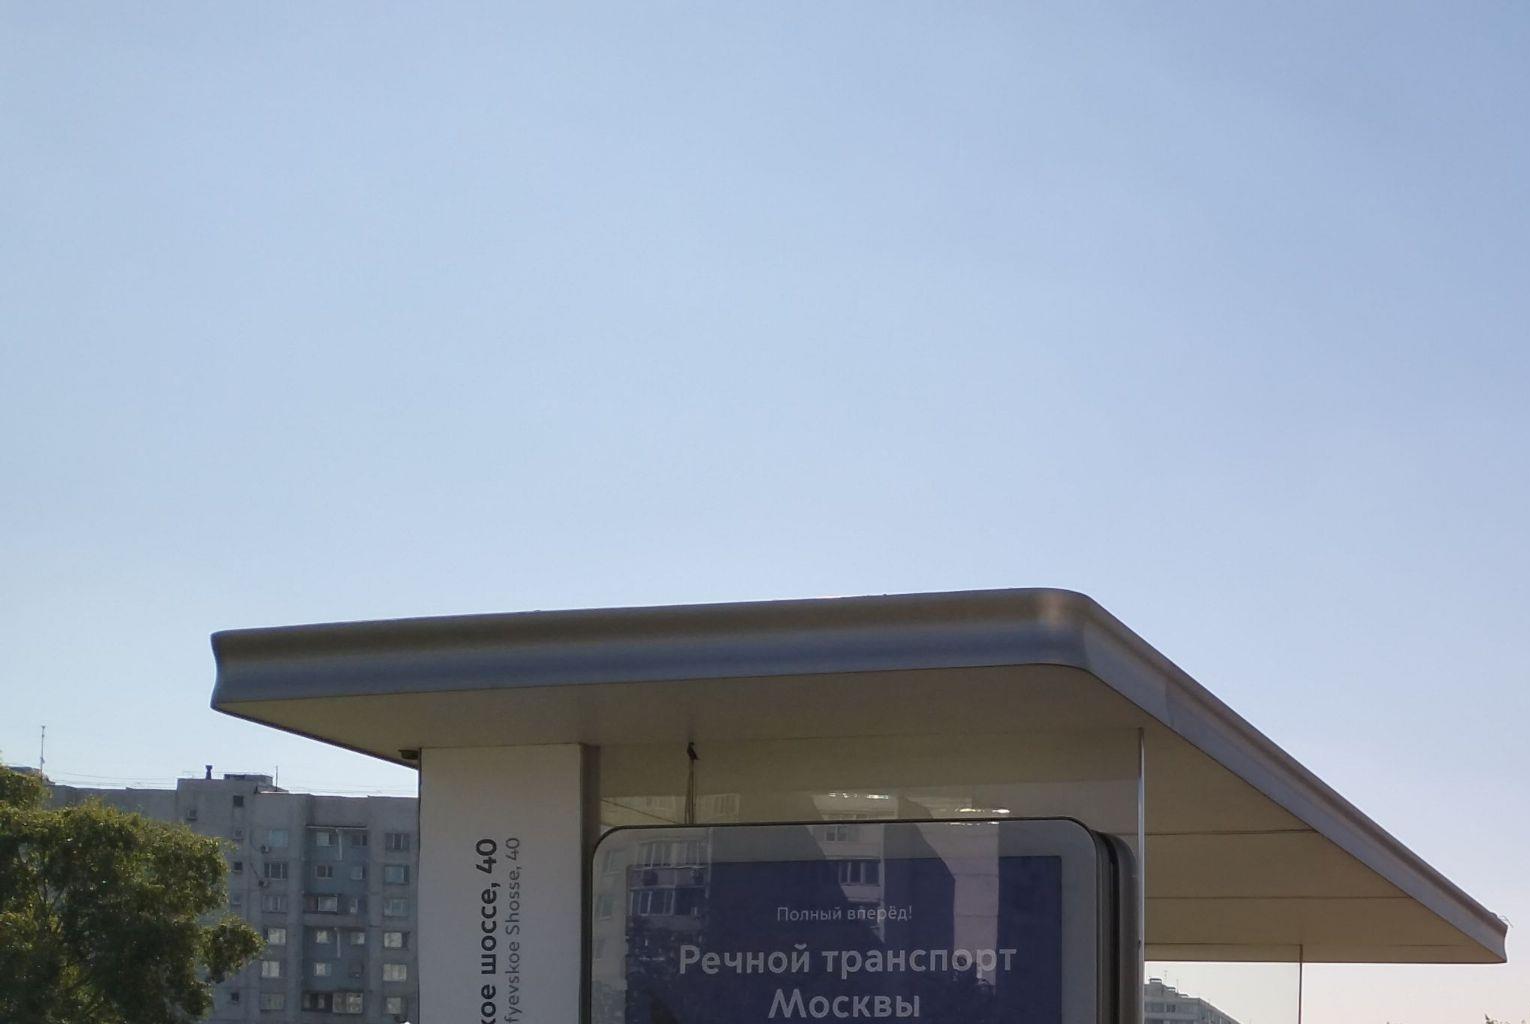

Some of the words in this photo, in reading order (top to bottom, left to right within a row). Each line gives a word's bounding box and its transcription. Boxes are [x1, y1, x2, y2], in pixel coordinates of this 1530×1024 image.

[475, 838, 498, 875] 40
[505, 837, 521, 861] 40
[504, 866, 523, 936] Shosse,
[777, 907, 842, 921] Полный
[847, 905, 912, 923] вперёд!
[480, 882, 502, 975] шоссе,
[680, 943, 810, 975] Речной
[822, 948, 1017, 980] транспорт
[768, 988, 920, 1019] Москвы
